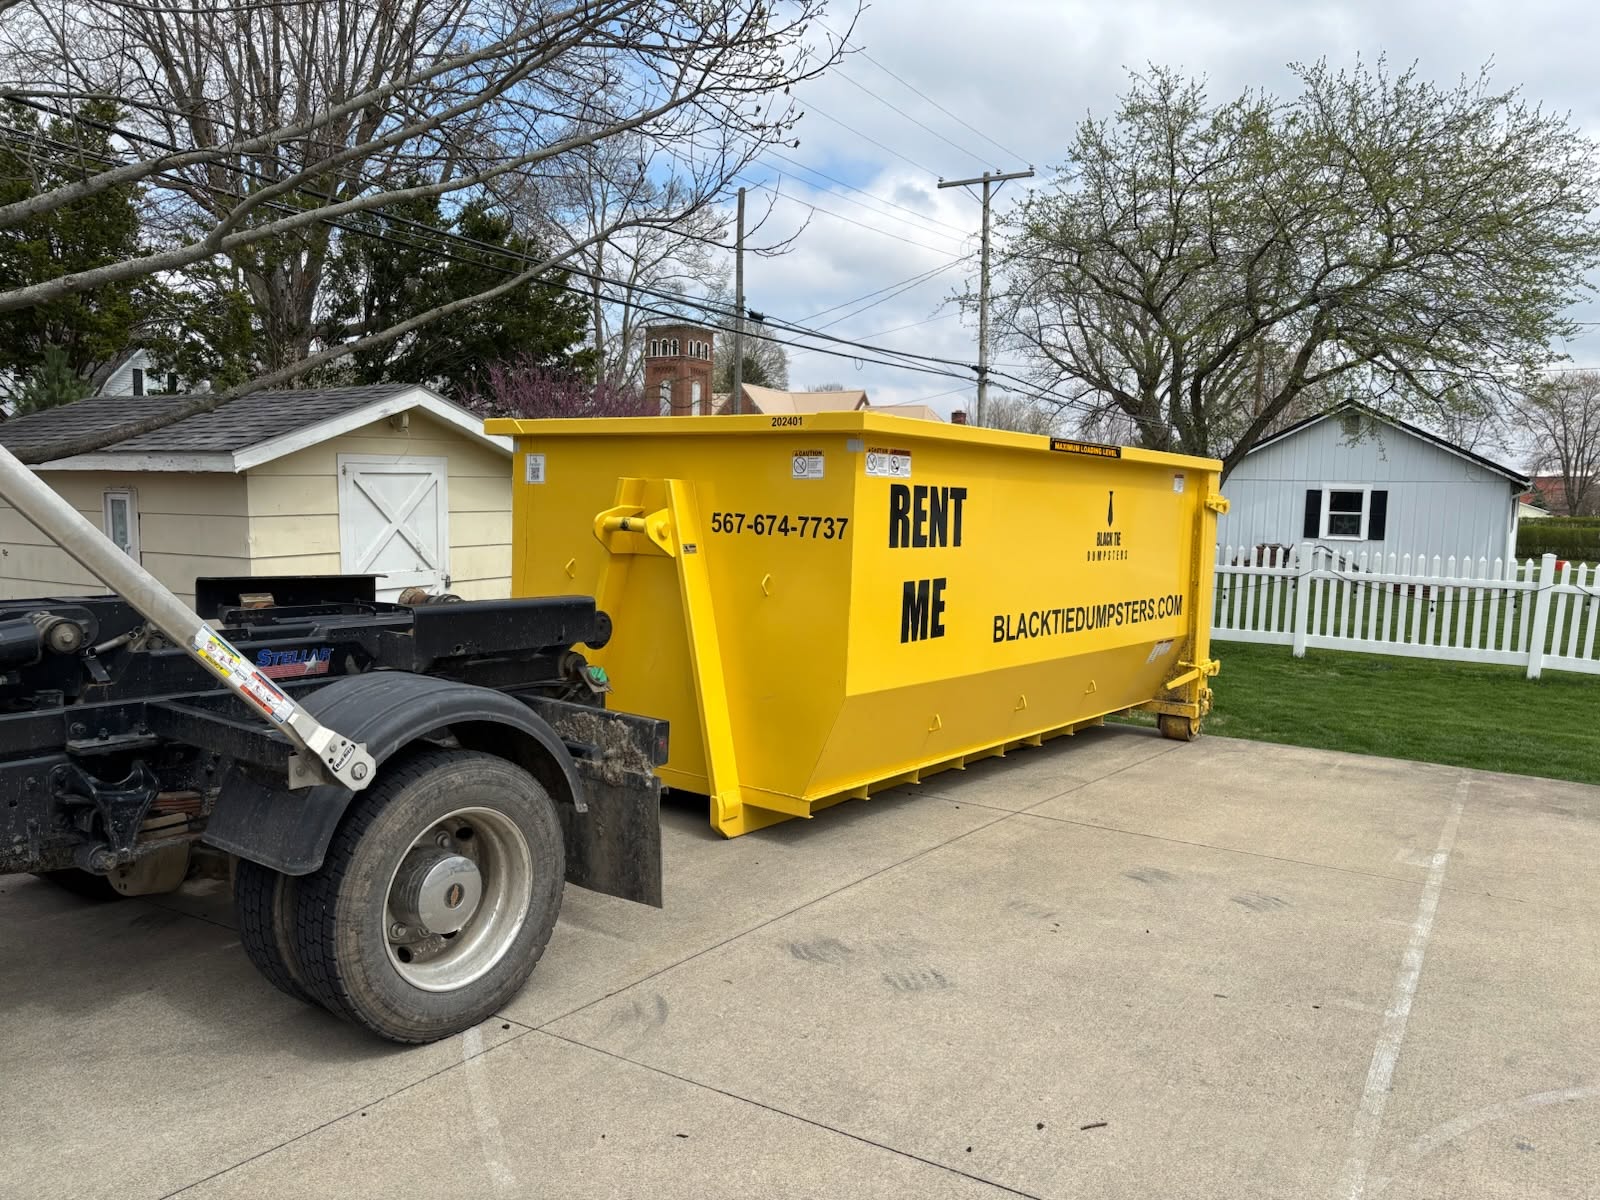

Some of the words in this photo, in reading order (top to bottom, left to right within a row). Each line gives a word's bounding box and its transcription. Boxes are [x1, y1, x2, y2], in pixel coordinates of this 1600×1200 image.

[771, 416, 803, 427] 202401
[1054, 441, 1080, 452] MAXIMUM
[1081, 445, 1102, 455] LOADING
[1102, 448, 1118, 457] LEVEL
[711, 512, 849, 540] 567-674-7737
[889, 484, 967, 548] RENT
[1096, 531, 1113, 547] BLACK
[1087, 550, 1128, 562] DUMPSTERS
[900, 577, 947, 644] ME
[993, 594, 1183, 644] BLACKTIEDUMPSTERS.COM
[256, 648, 331, 668] STELLAR
